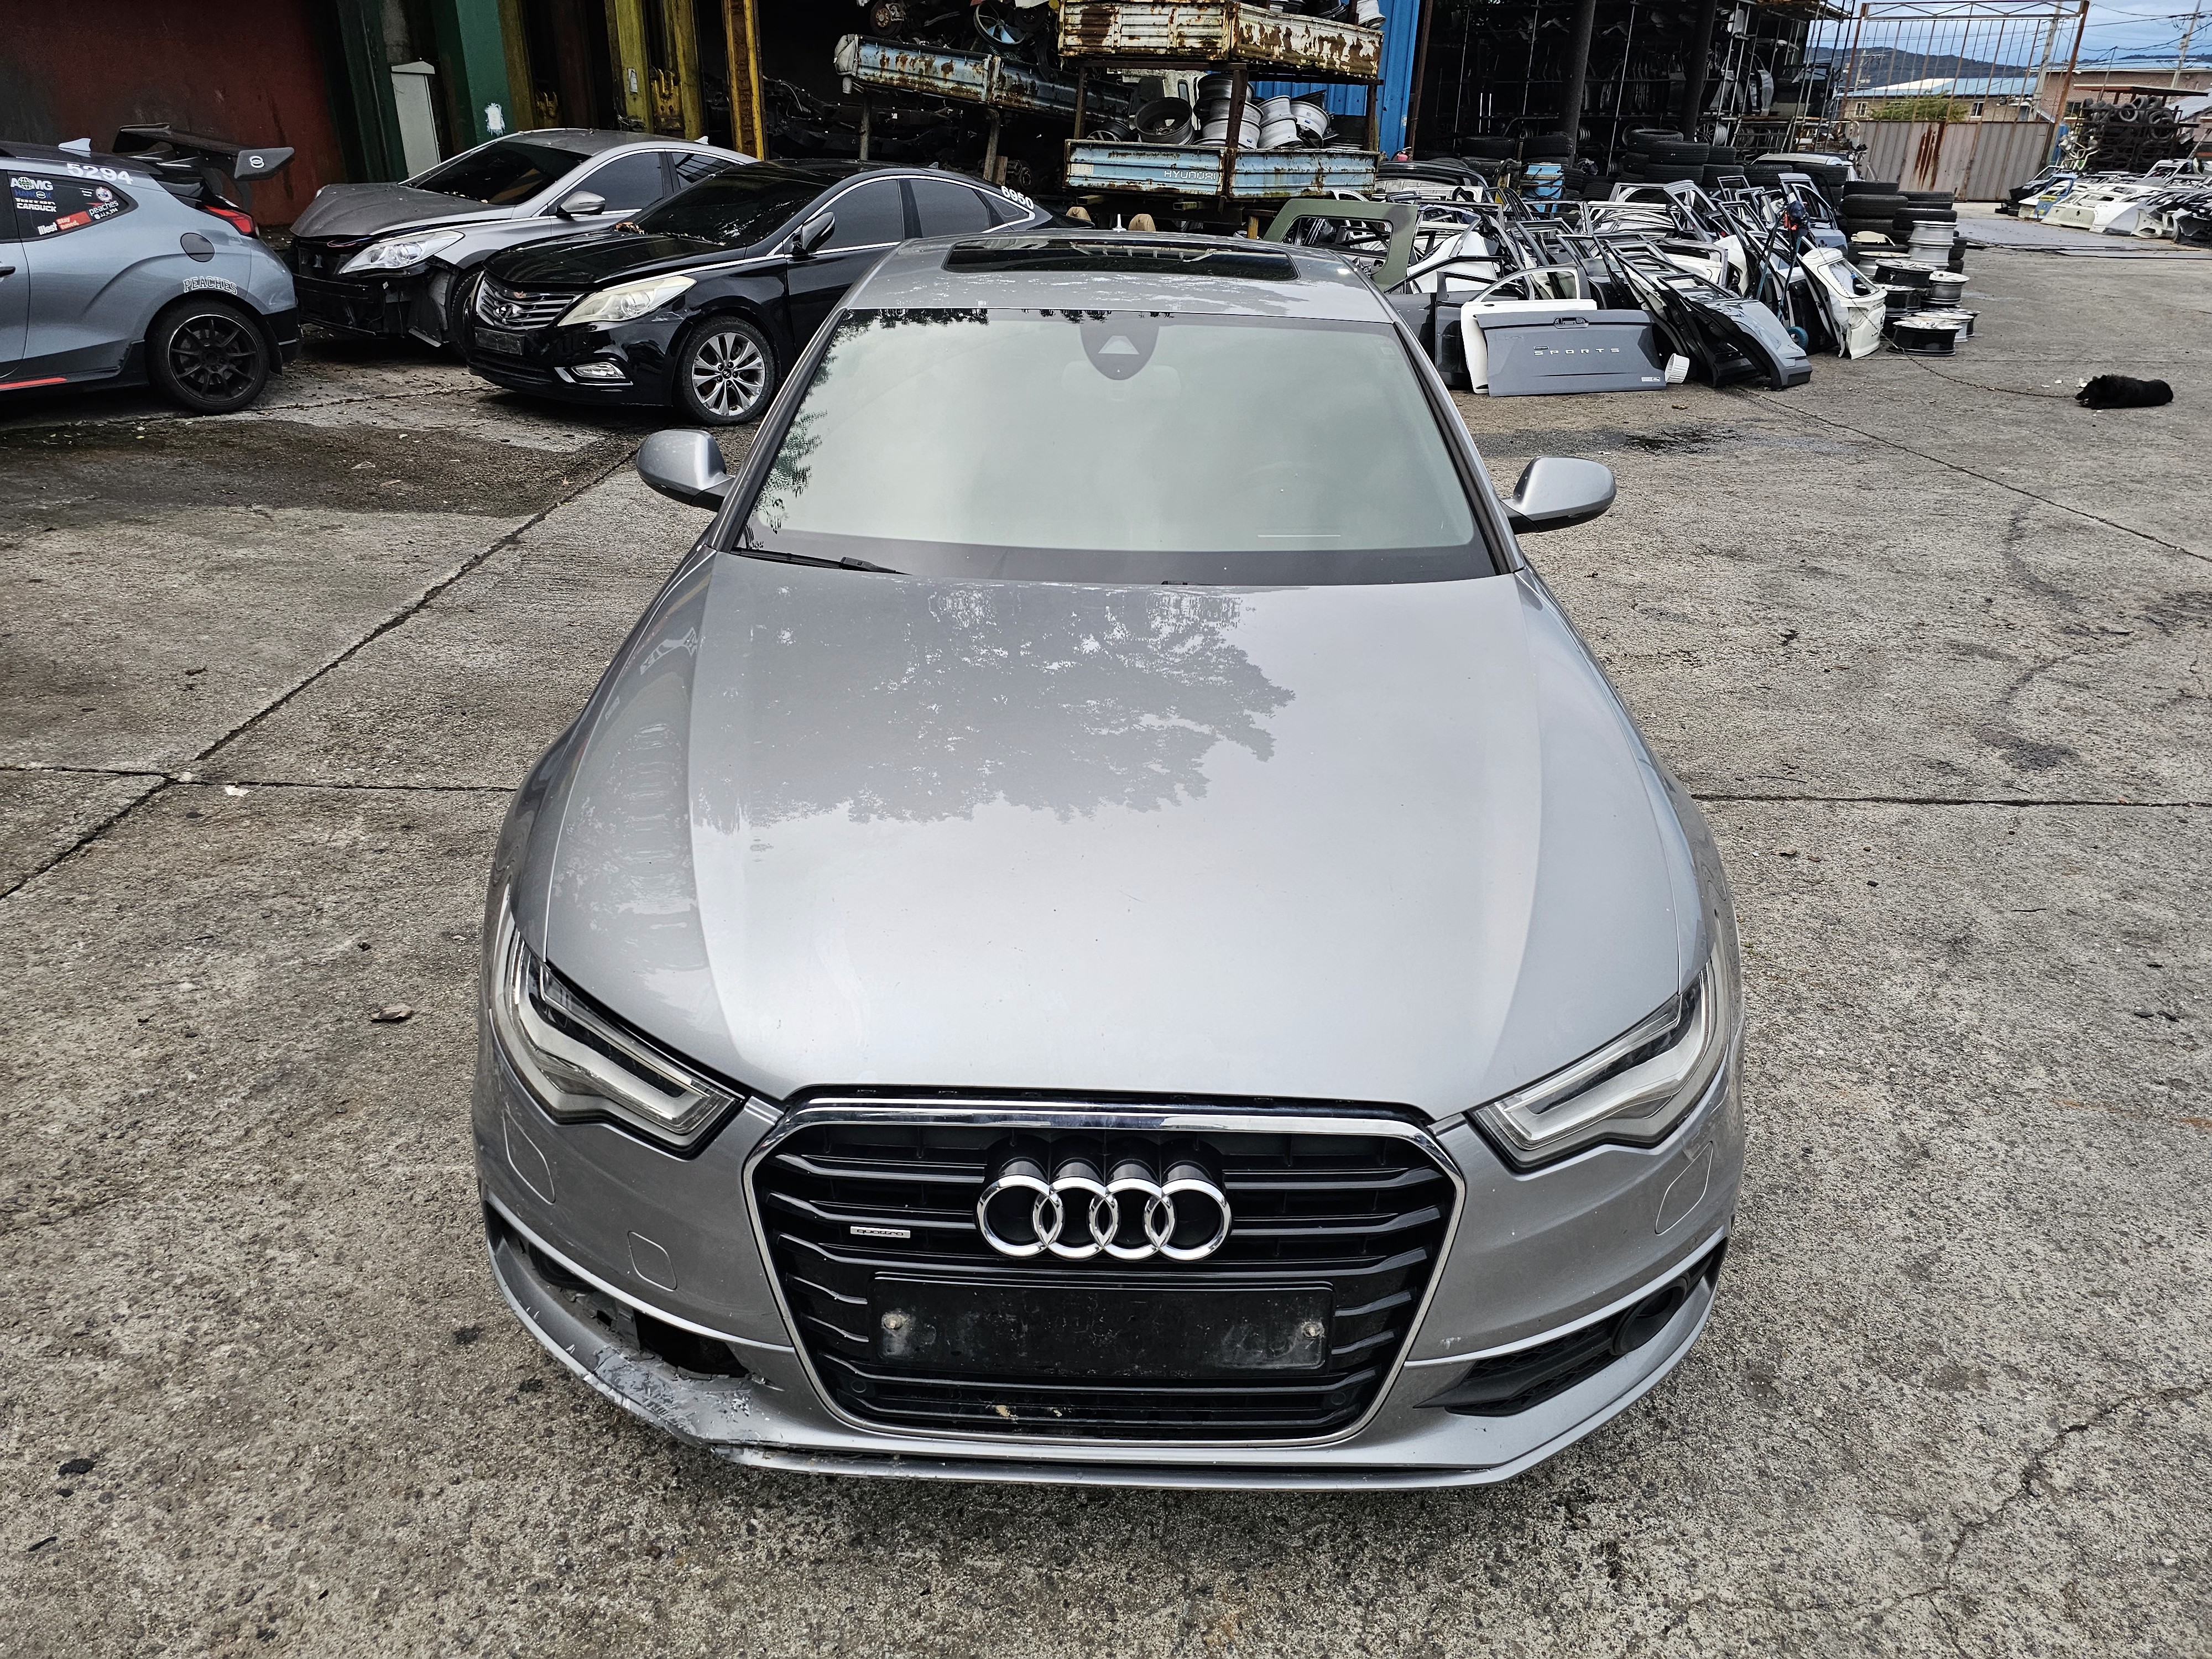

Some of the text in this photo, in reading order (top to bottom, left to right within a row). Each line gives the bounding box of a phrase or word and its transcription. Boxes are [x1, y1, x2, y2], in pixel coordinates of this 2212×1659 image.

[67, 163, 133, 184] 5294
[1164, 170, 1216, 180] HYUNDAI
[1001, 185, 1034, 210] 6950
[89, 201, 119, 216] peaches
[183, 276, 238, 295] PEACHES
